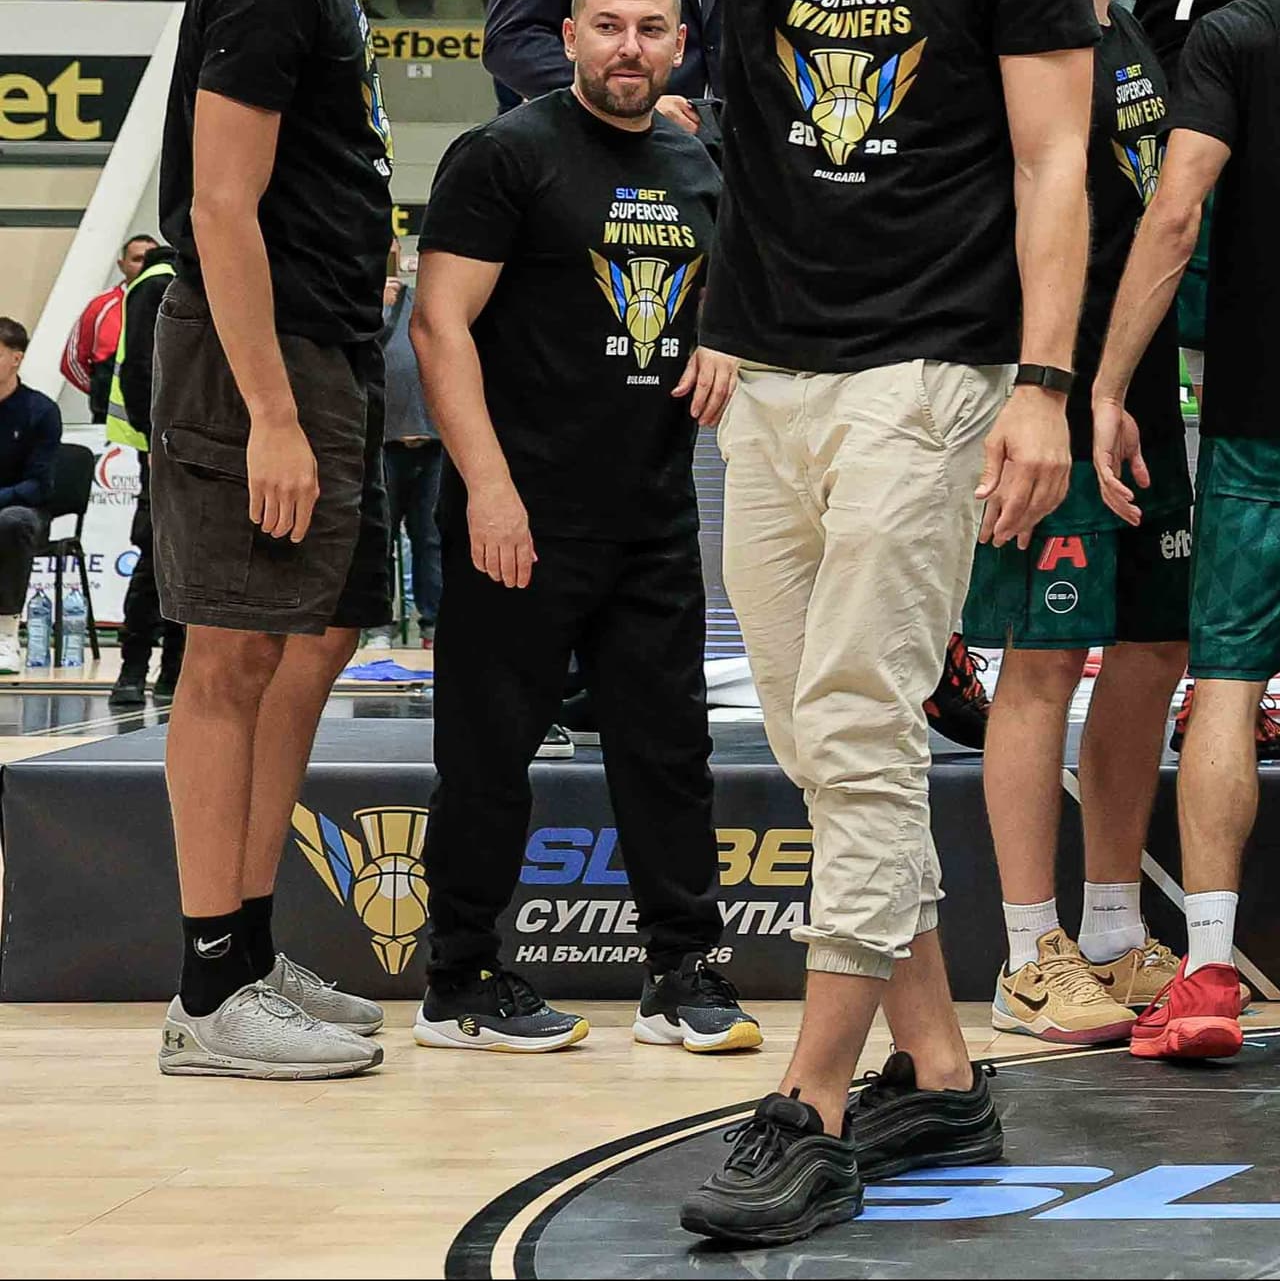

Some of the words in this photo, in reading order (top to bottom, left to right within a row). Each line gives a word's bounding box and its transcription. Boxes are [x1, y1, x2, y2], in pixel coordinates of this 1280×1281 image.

[786, 0, 912, 39] WINNERS
[372, 29, 480, 59] efbet
[788, 120, 818, 147] 20
[813, 169, 866, 183] BULGARIA
[615, 187, 667, 202] SLYBET
[609, 202, 680, 222] SUPERCUP
[603, 221, 696, 248] WINNERS
[605, 336, 629, 356] 20
[661, 337, 680, 358] 26
[626, 375, 660, 385] BULGARIA
[519, 827, 813, 886] SLBE
[515, 945, 548, 963] НА
[552, 945, 648, 963] БЪЛГАР
